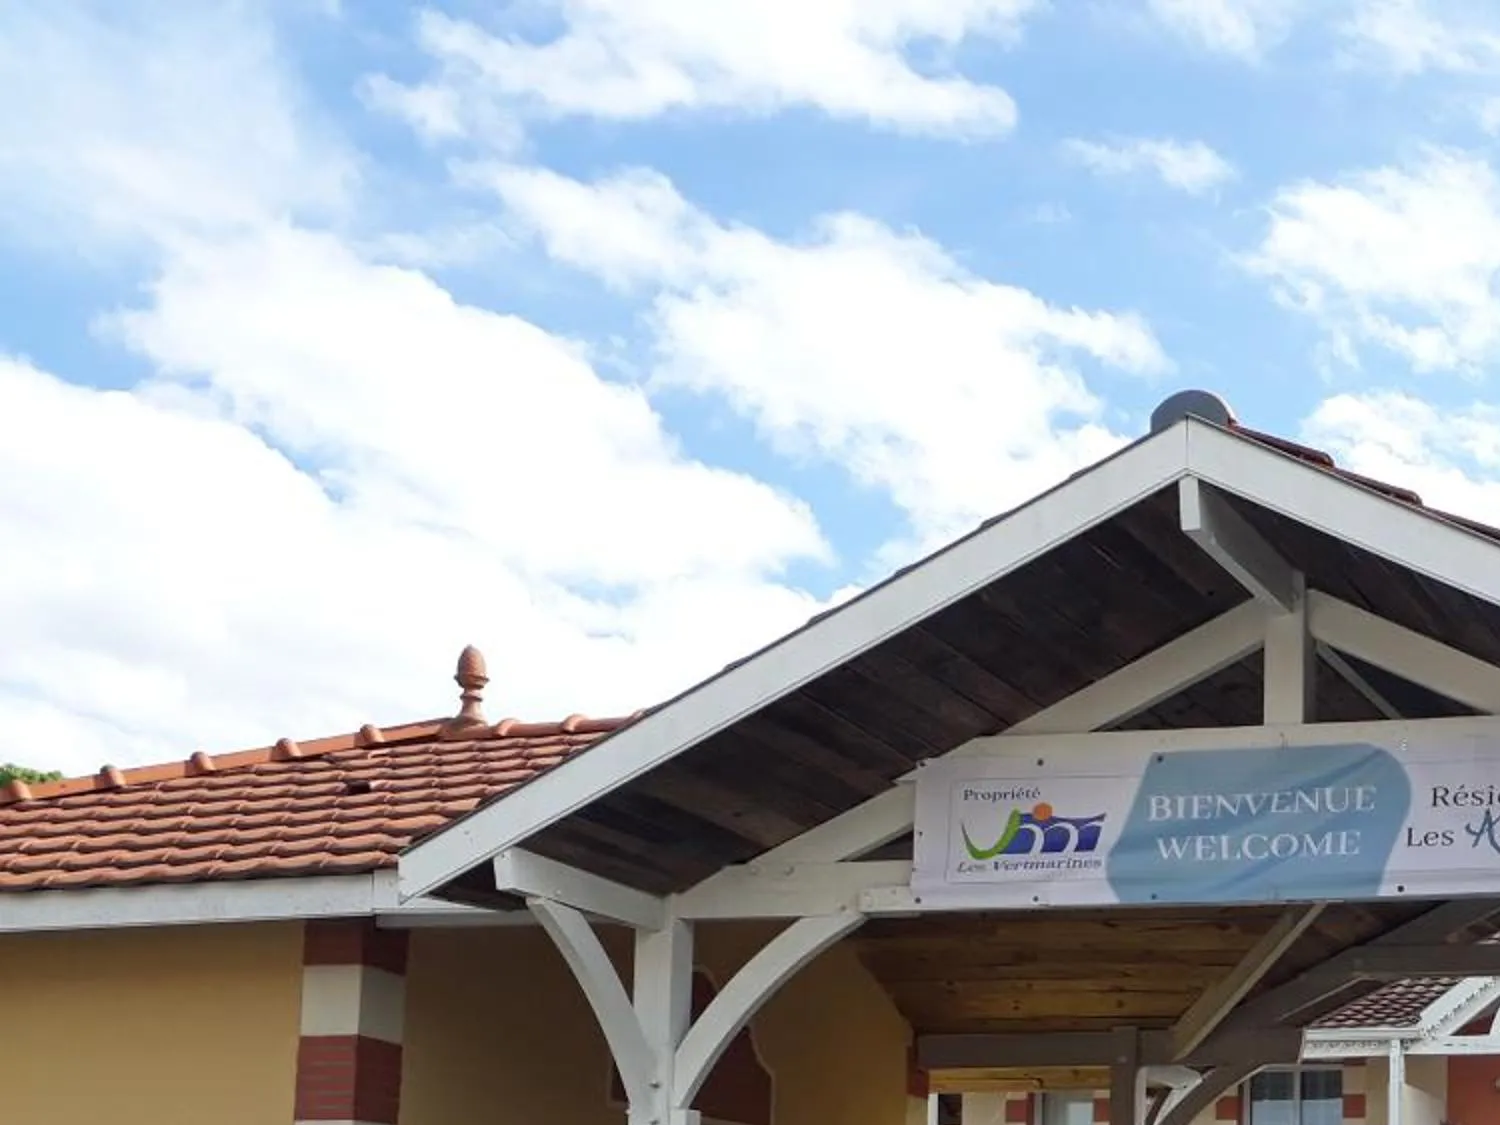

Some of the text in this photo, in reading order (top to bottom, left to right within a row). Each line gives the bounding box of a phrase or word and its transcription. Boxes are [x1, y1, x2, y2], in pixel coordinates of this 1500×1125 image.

[963, 786, 1041, 803] Propriété
[1148, 785, 1378, 822] BIENVENUE
[1156, 831, 1362, 861] WELCOME
[1406, 826, 1455, 848] Les
[957, 860, 986, 873] Les
